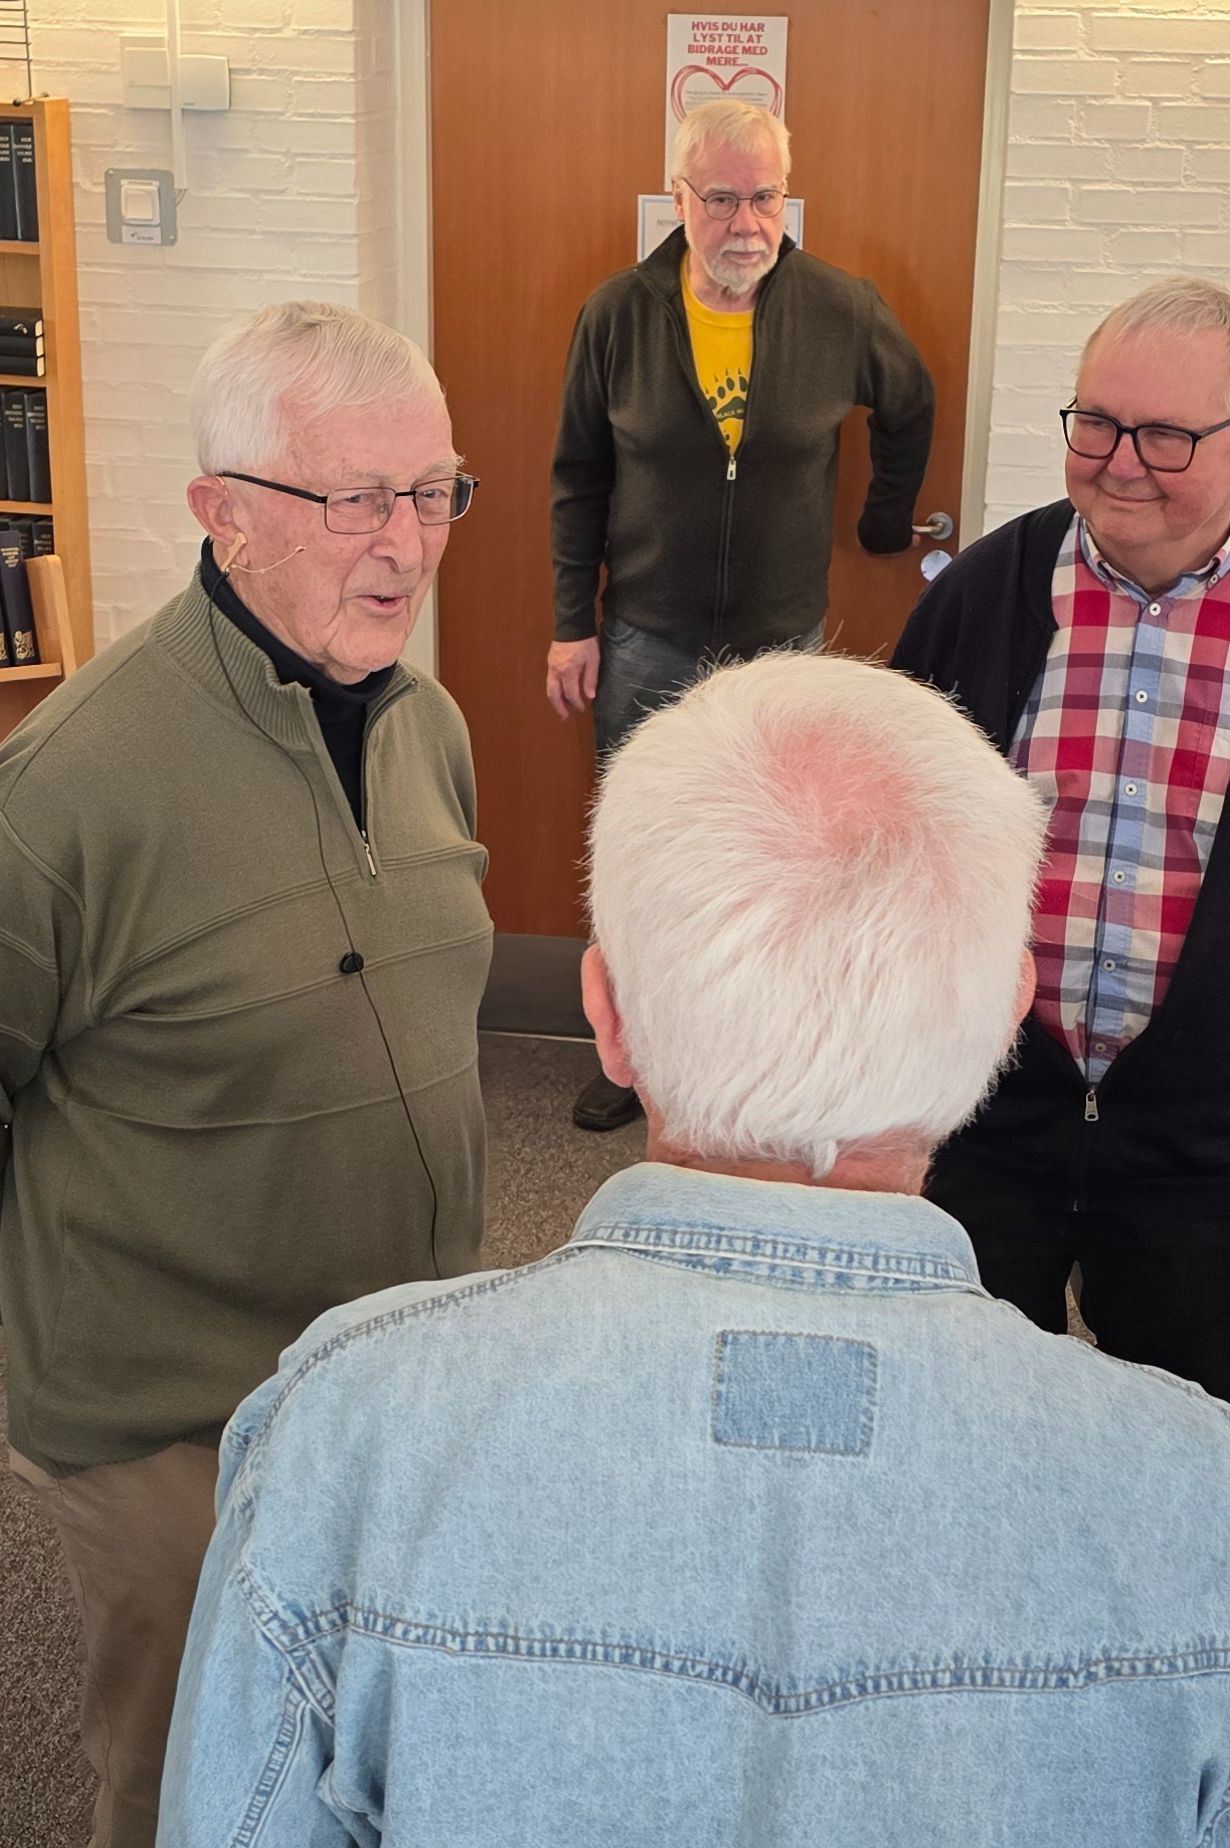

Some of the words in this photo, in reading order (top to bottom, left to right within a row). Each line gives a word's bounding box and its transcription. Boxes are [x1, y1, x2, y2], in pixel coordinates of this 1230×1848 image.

[691, 21, 719, 32] HVIS
[721, 22, 738, 32] DU
[740, 22, 765, 32] HAR
[693, 34, 723, 43] LYST
[726, 34, 744, 43] TIL
[746, 34, 763, 44] AT
[687, 44, 740, 55] BIDRAGE
[741, 46, 768, 55] MED
